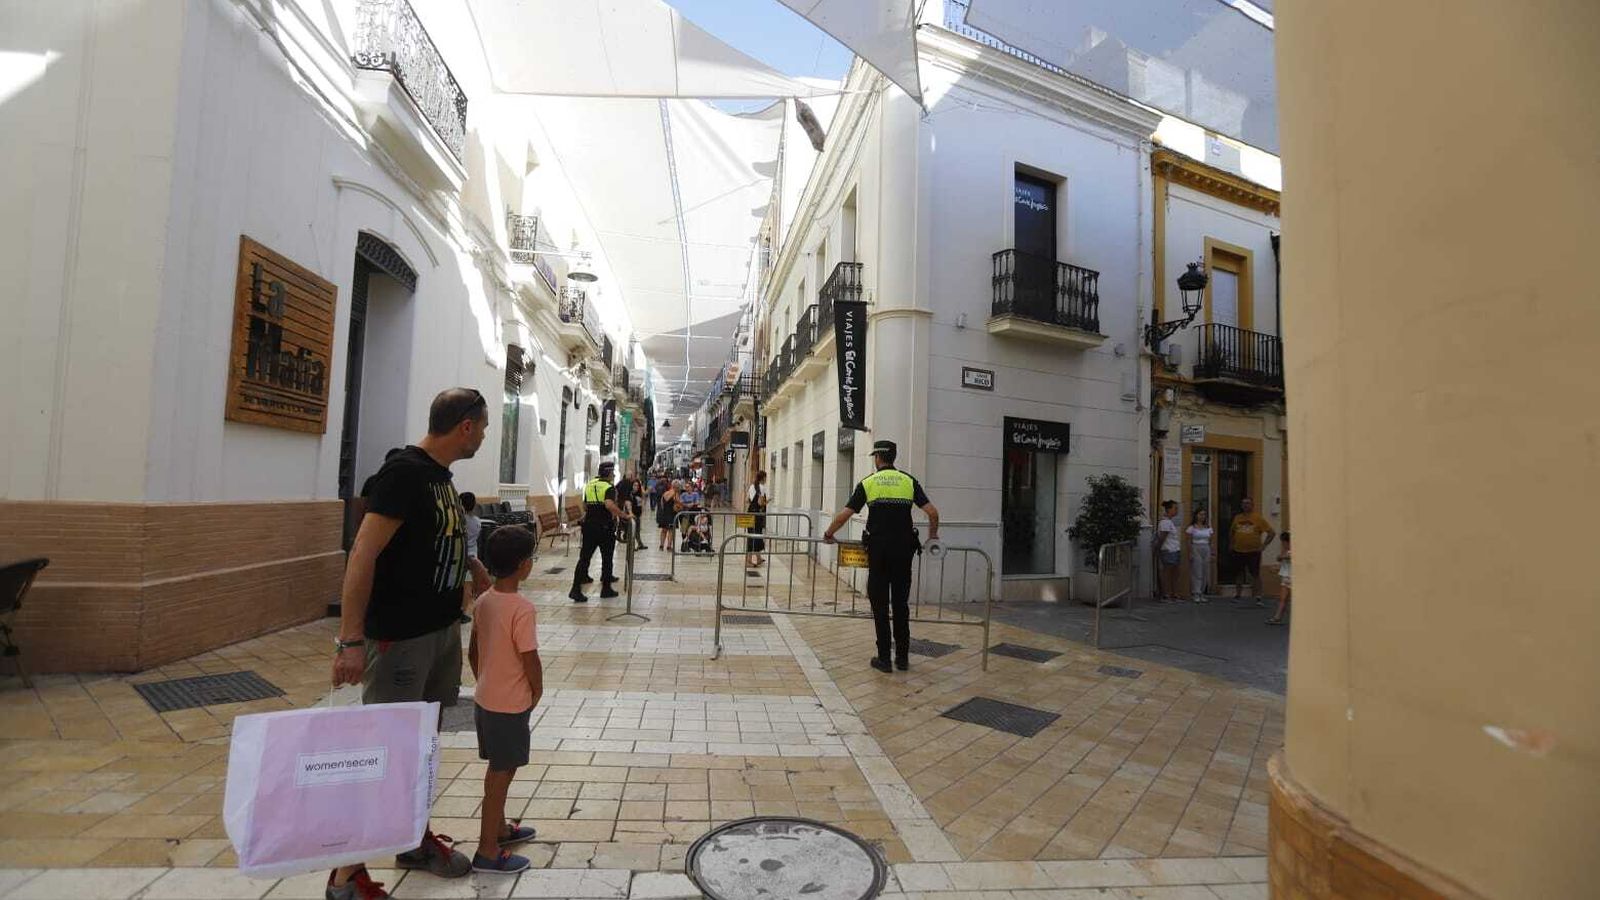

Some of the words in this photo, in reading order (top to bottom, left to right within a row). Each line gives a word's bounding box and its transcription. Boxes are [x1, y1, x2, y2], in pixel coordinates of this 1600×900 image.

[252, 263, 284, 318] La
[844, 311, 854, 348] VIAJES
[845, 350, 857, 360] El
[1014, 423, 1039, 431] VIAJES
[305, 758, 378, 771] women'secret
